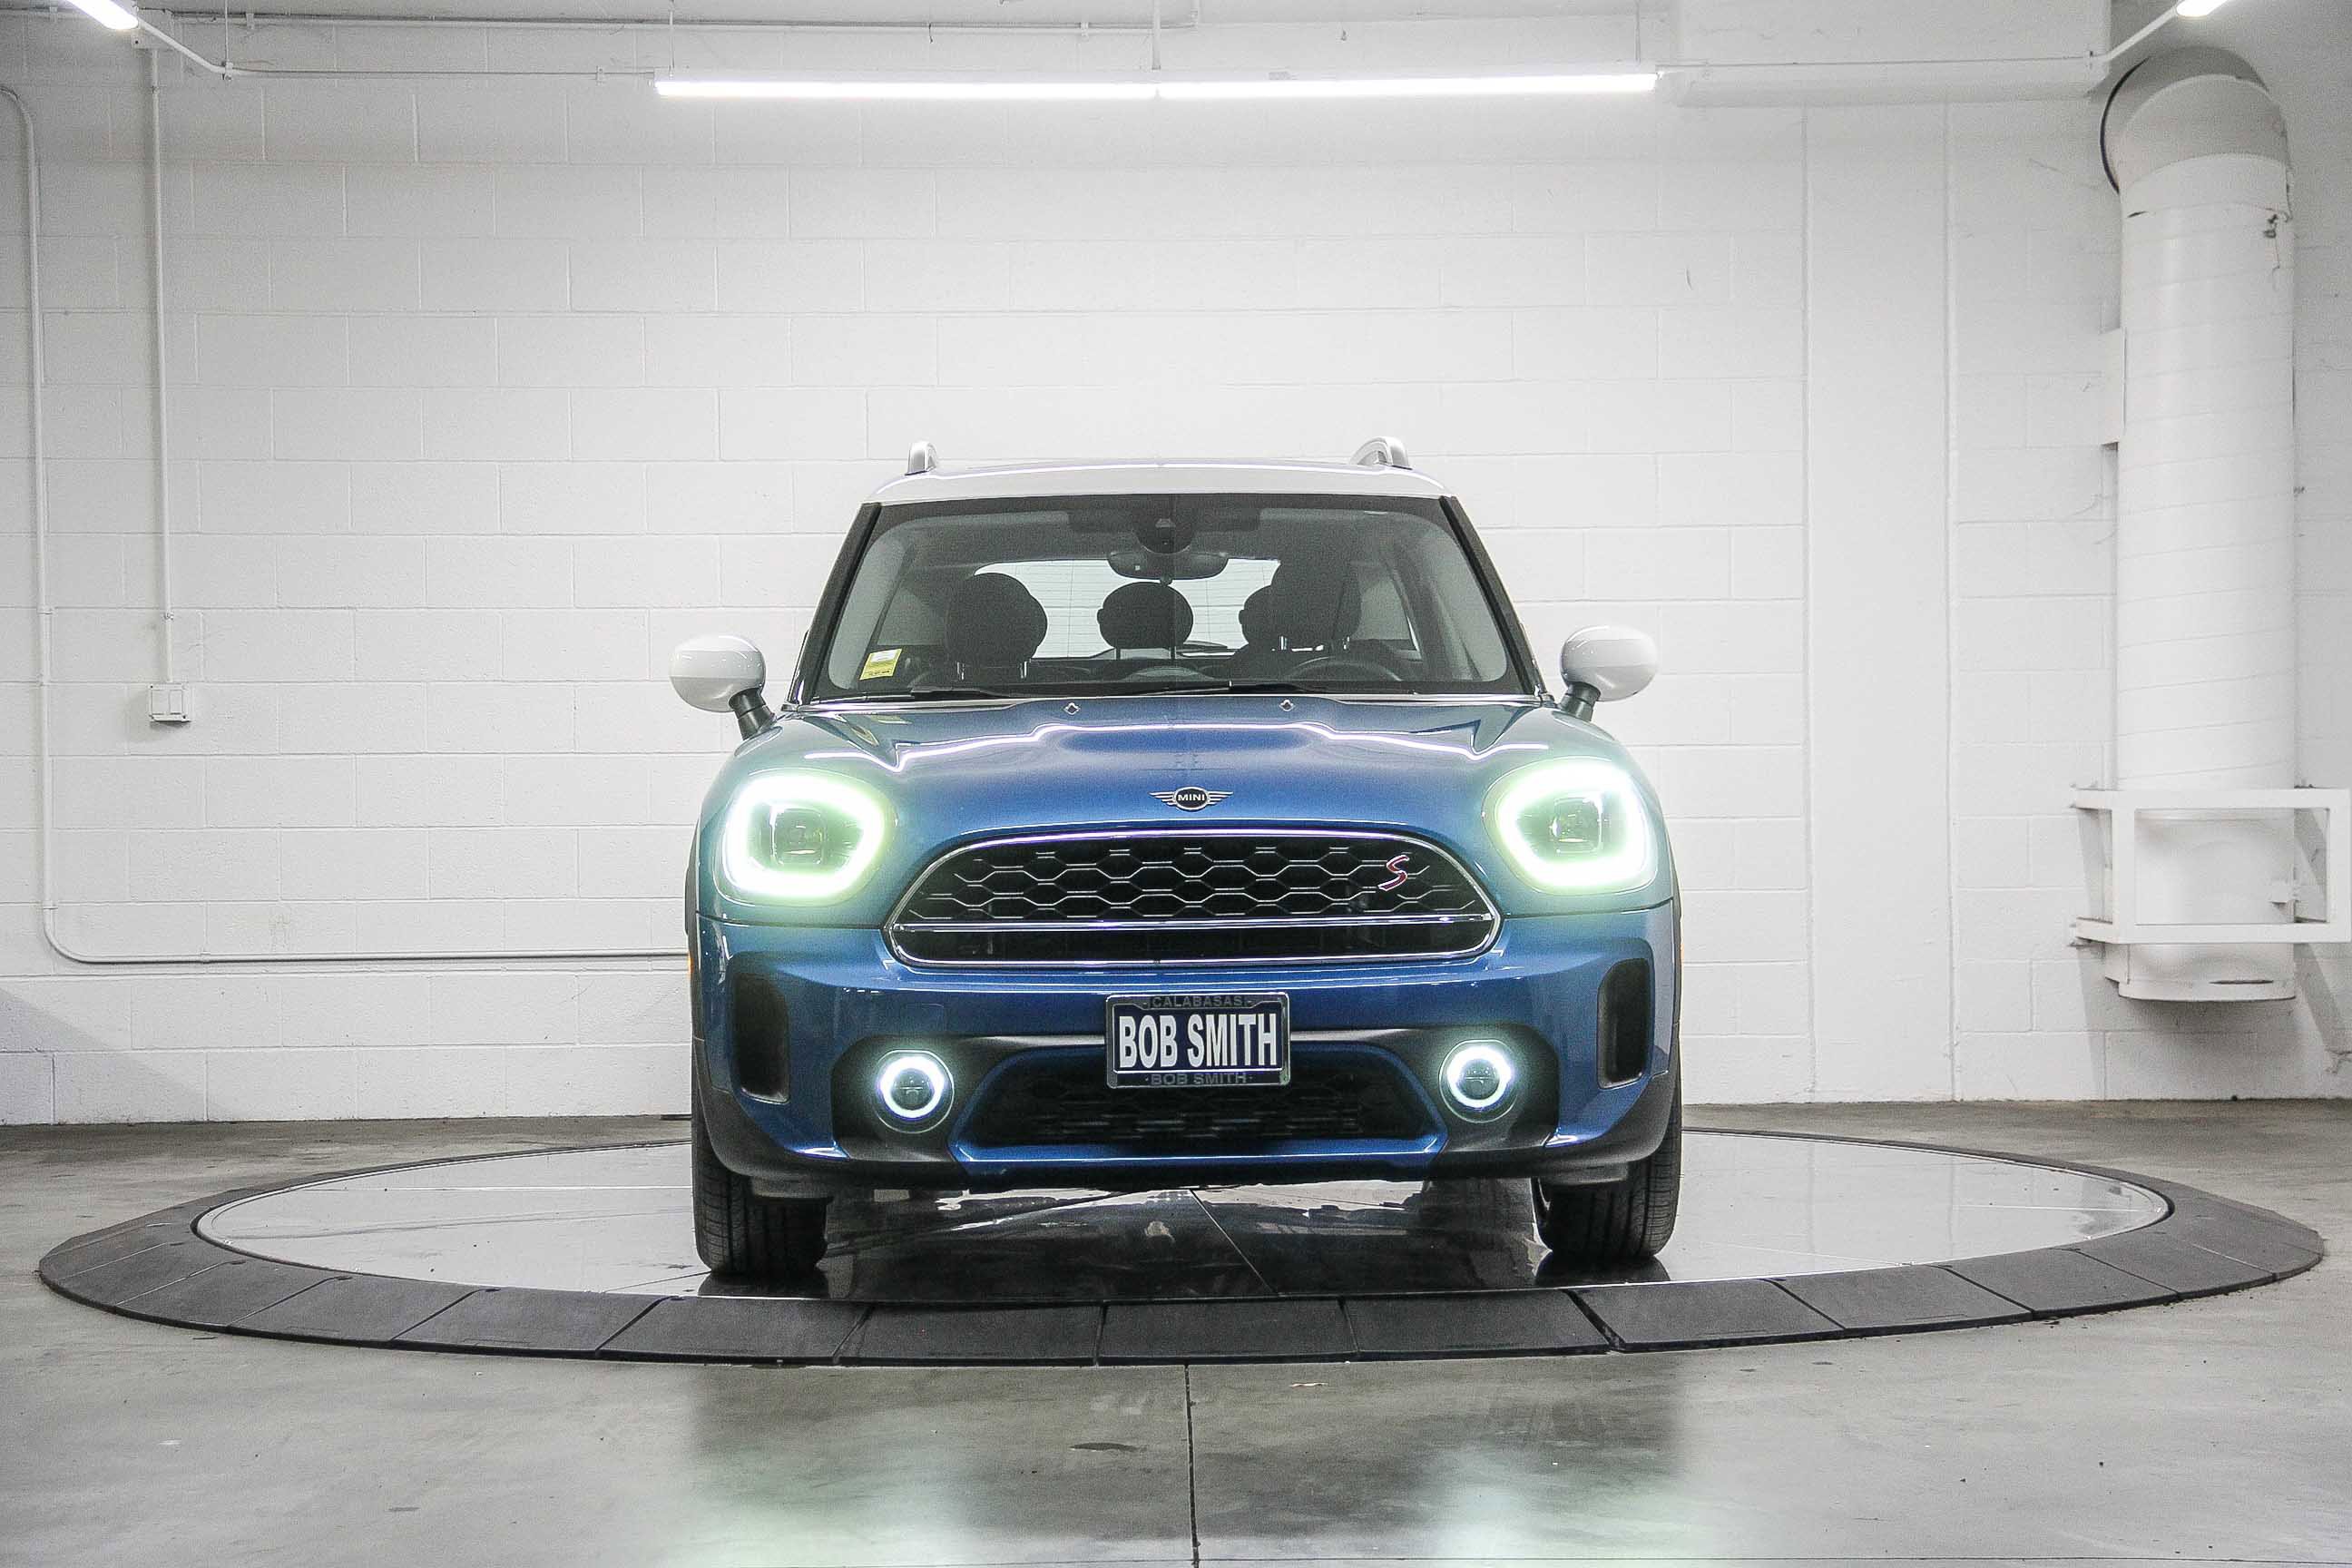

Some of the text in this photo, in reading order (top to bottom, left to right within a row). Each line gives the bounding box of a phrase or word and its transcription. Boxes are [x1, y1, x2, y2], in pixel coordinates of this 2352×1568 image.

[1377, 855, 1410, 892] S
[1152, 995, 1242, 1007] CALABASAS
[1119, 1014, 1277, 1069] BOB SMITH
[1151, 1072, 1247, 1085] BOB SMITH
